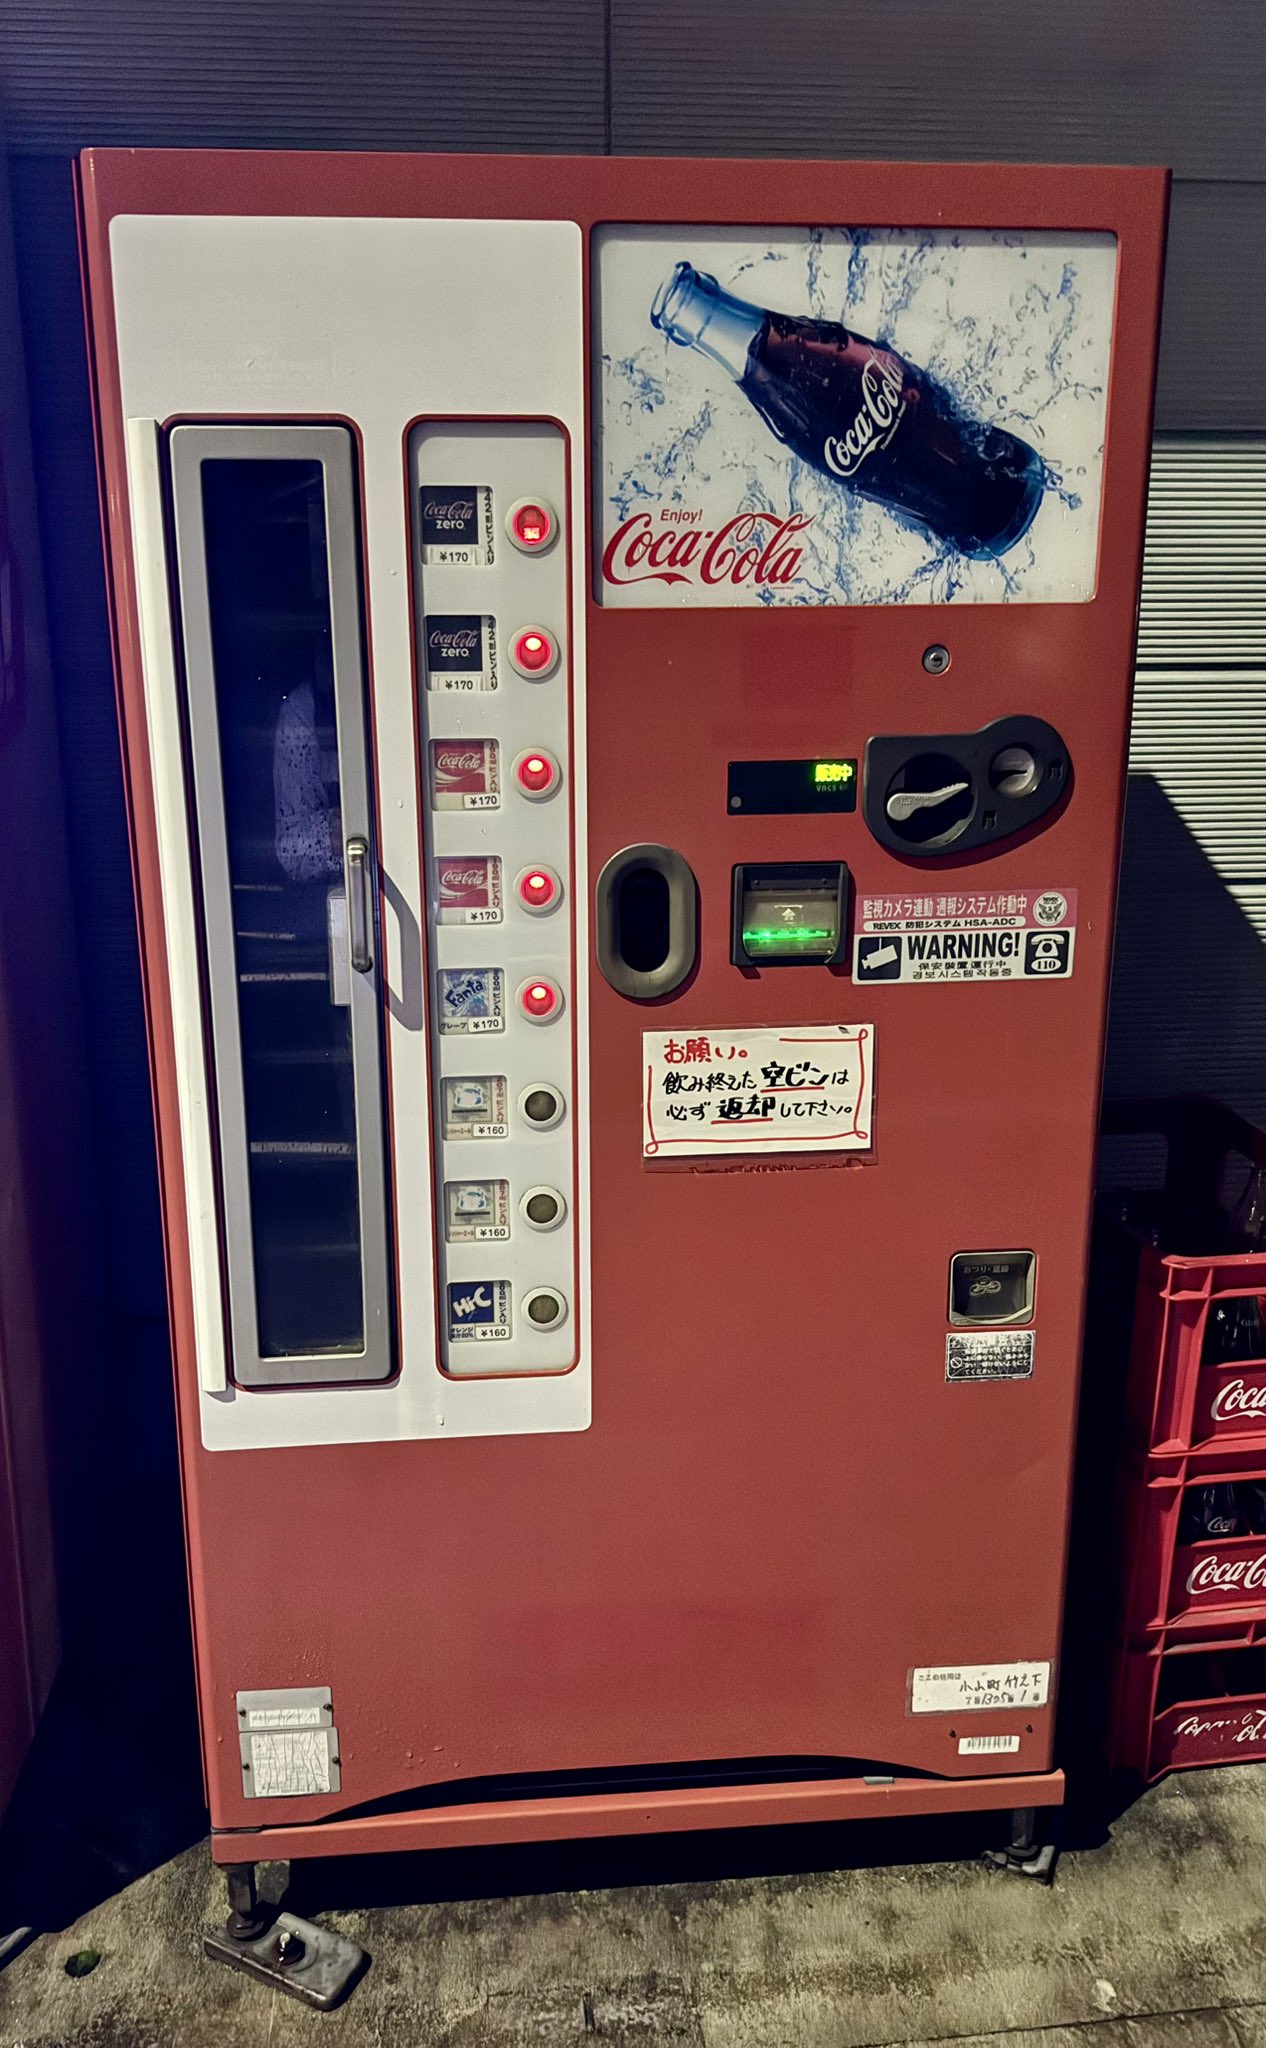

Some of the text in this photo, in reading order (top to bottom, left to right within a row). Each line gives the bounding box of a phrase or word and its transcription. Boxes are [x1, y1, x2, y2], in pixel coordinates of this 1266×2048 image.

[660, 509, 703, 524] Enjoy!
[436, 520, 465, 529] zero
[602, 513, 817, 585] Coca-Cola
[440, 551, 469, 562] ¥170
[441, 648, 470, 657] zero
[445, 680, 474, 690] ¥170
[470, 795, 498, 806] ¥170
[863, 895, 1028, 919] 監視カメラ連動 通報システム作動中
[471, 911, 498, 921] ¥170
[873, 917, 1017, 930] REVEX 防犯システム HSA-ADC
[907, 932, 1020, 960] WARNING!
[1036, 960, 1056, 969] 110
[445, 979, 484, 1008] Fanta
[440, 1022, 467, 1030] グレープ
[473, 1019, 500, 1029] ¥170
[663, 1037, 749, 1064] お願い。
[478, 1126, 505, 1135] ¥160
[480, 1228, 506, 1237] ¥160
[481, 1328, 507, 1337] ¥160
